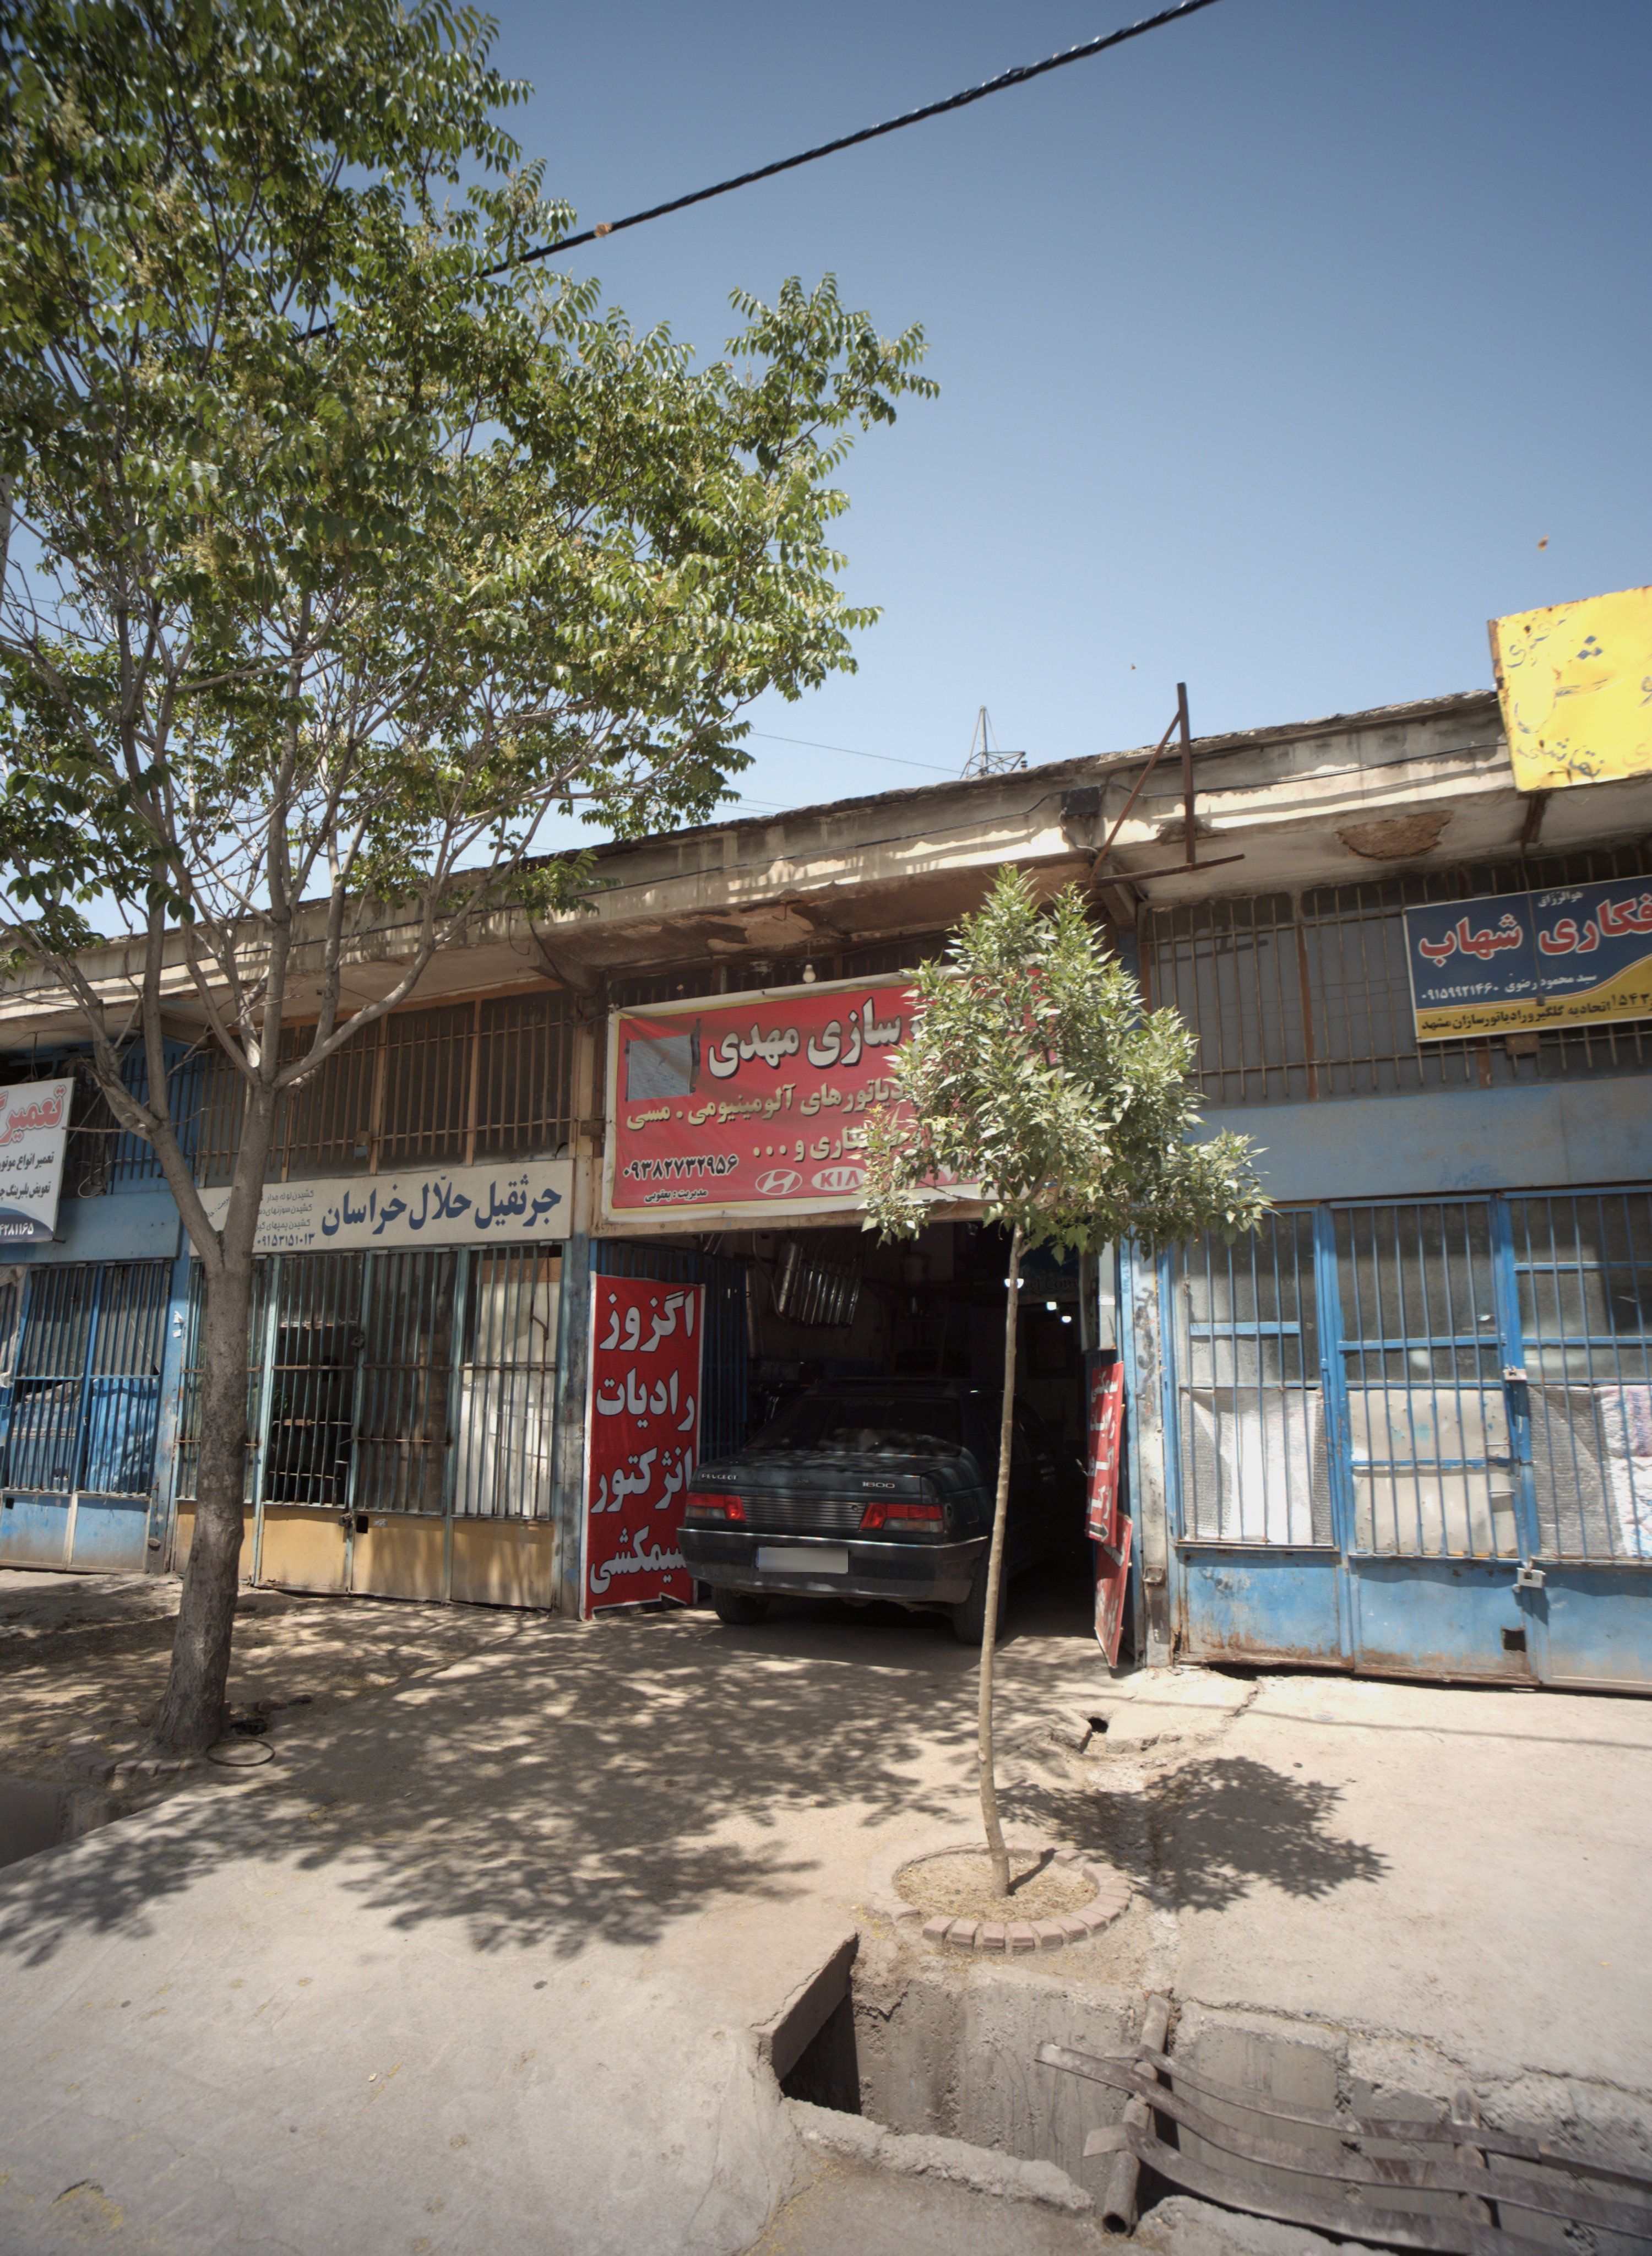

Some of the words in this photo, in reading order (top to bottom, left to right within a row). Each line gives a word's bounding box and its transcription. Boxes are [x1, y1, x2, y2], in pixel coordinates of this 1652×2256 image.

[1419, 913, 1523, 967] شهاب
[1504, 979, 1538, 993] رضوی
[1540, 977, 1574, 990] محمود
[1576, 974, 1597, 984] سید
[1569, 1001, 1611, 1018] اتحادیه
[807, 997, 901, 1067] سازی
[1422, 1018, 1452, 1030] مشهد
[709, 1023, 800, 1078] مهدی
[688, 1084, 796, 1124] آلومینیومی
[801, 1078, 904, 1115] دیاتورهای
[627, 1107, 671, 1130] مسی
[0, 1155, 17, 1172] موتو
[17, 1153, 35, 1170] انواع
[34, 1152, 55, 1169] تعمیر
[623, 1154, 738, 1181] ۰۹۳۸۲۷۳۲۹۵۶
[820, 1170, 860, 1187] KIA
[6, 1183, 29, 1200] بلبرینگ
[29, 1181, 51, 1198] تعویض
[293, 1189, 314, 1201] کشیدن
[291, 1203, 313, 1214] کشیدن
[321, 1184, 407, 1236] خراسان
[474, 1174, 562, 1230] جرثقیل
[289, 1218, 311, 1230] کشیدن
[599, 1289, 695, 1353] اگزوز
[596, 1366, 695, 1431] رادیات
[590, 1445, 692, 1514] انژکتور
[701, 1473, 739, 1481] PEUGEOT
[862, 1480, 895, 1489] 1600
[590, 1525, 687, 1595] سیمکشی
